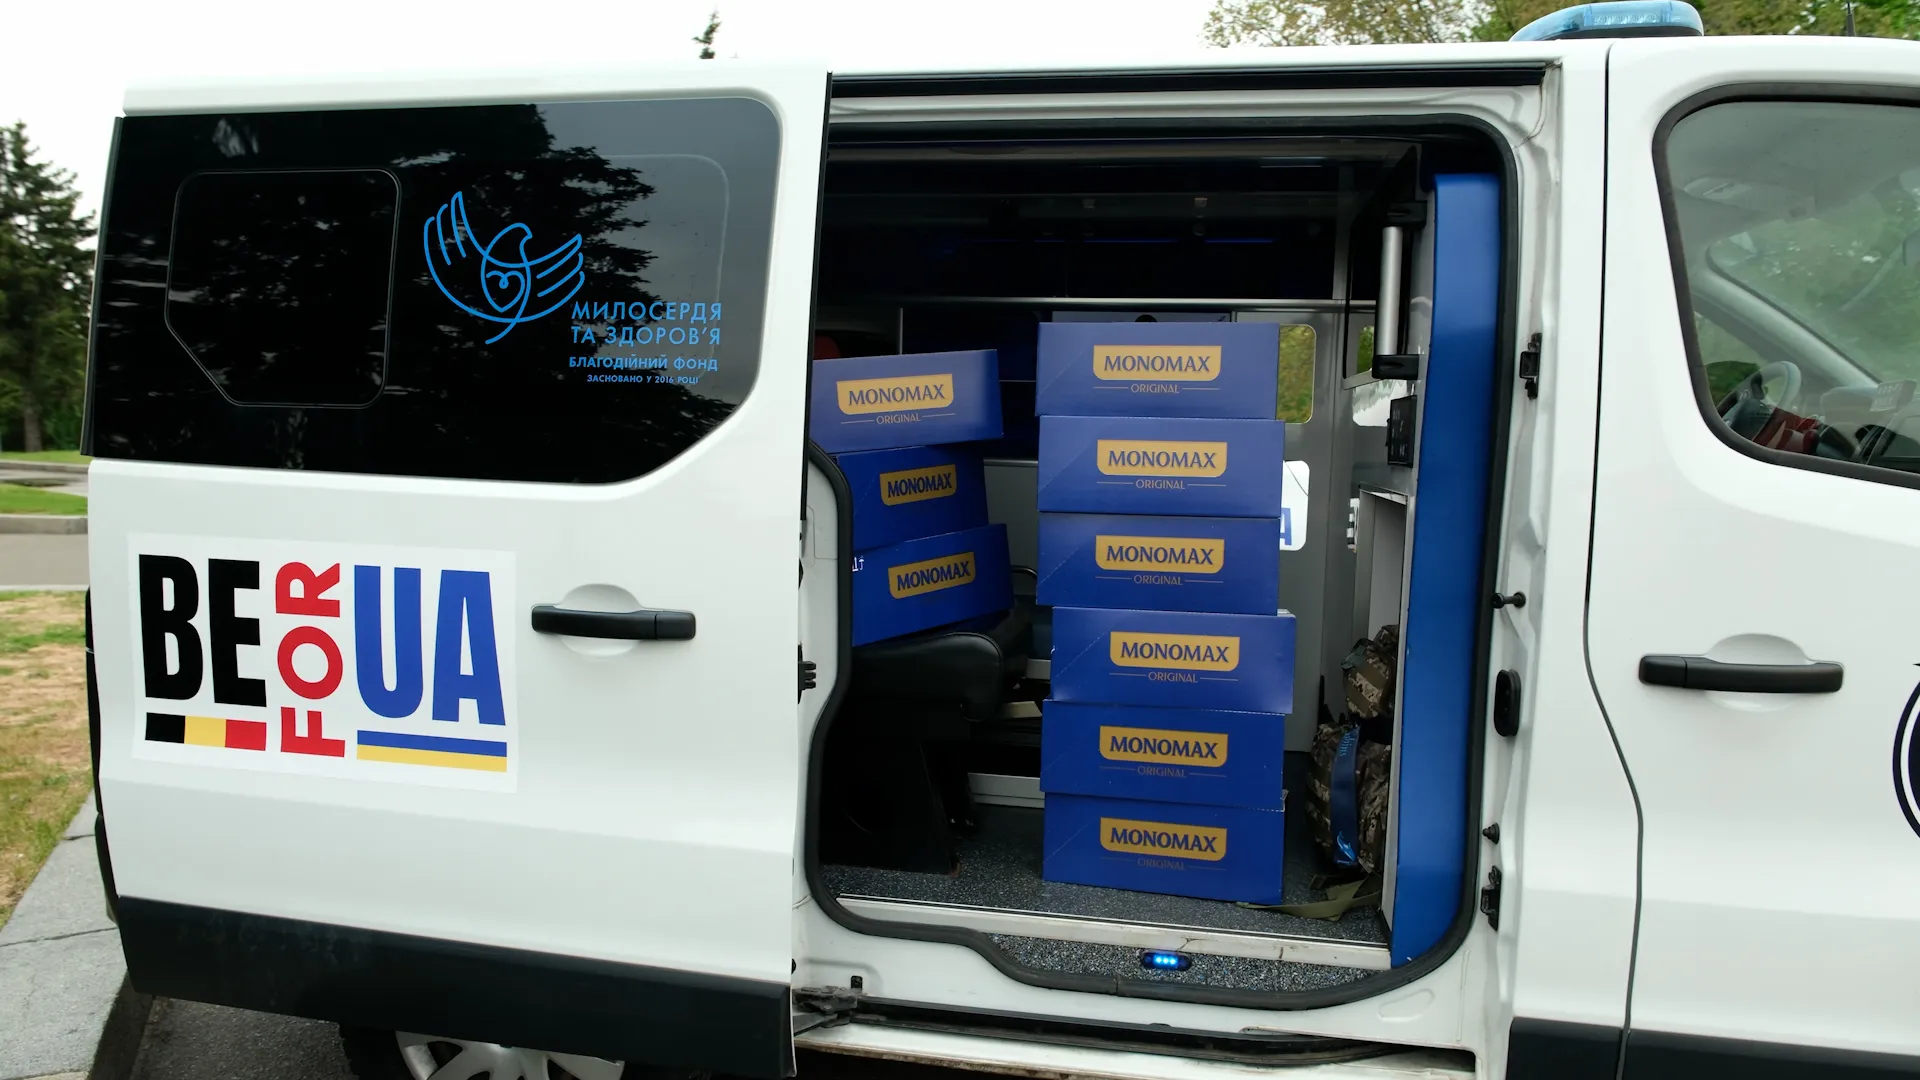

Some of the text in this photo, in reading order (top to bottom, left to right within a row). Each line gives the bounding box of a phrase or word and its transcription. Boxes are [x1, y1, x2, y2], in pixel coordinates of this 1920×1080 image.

[571, 302, 722, 323] МИЛОСЕРДЯ
[571, 326, 596, 345] ТА
[568, 353, 718, 372] БЛАГОДІЙНИЙ ФОНД
[1104, 355, 1211, 373] MONOMAX
[587, 374, 699, 386] ЗАСНОВАНО У 2016 РОЦІ
[1130, 383, 1180, 395] ORIGINAL
[848, 383, 946, 407] MONOMAX
[875, 412, 922, 426] ORIGINAL
[1107, 450, 1217, 469] MONOMAX
[887, 473, 953, 499] MONOMAX
[1135, 479, 1186, 491] ORIGINAL
[1105, 545, 1214, 565] MONOMAX
[896, 560, 972, 592] MONOMAX
[1133, 574, 1184, 586] ORIGINAL
[138, 553, 268, 708] BE
[353, 564, 507, 727] UA
[1119, 641, 1230, 663] MONOMAX
[274, 561, 346, 758] FOR
[1148, 672, 1198, 684] ORIGINAL
[1109, 735, 1218, 760] MONOMAX
[1136, 765, 1187, 778] ORIGINAL
[1109, 827, 1217, 853] MONOMAX
[1136, 857, 1186, 871] ORIGINAL
